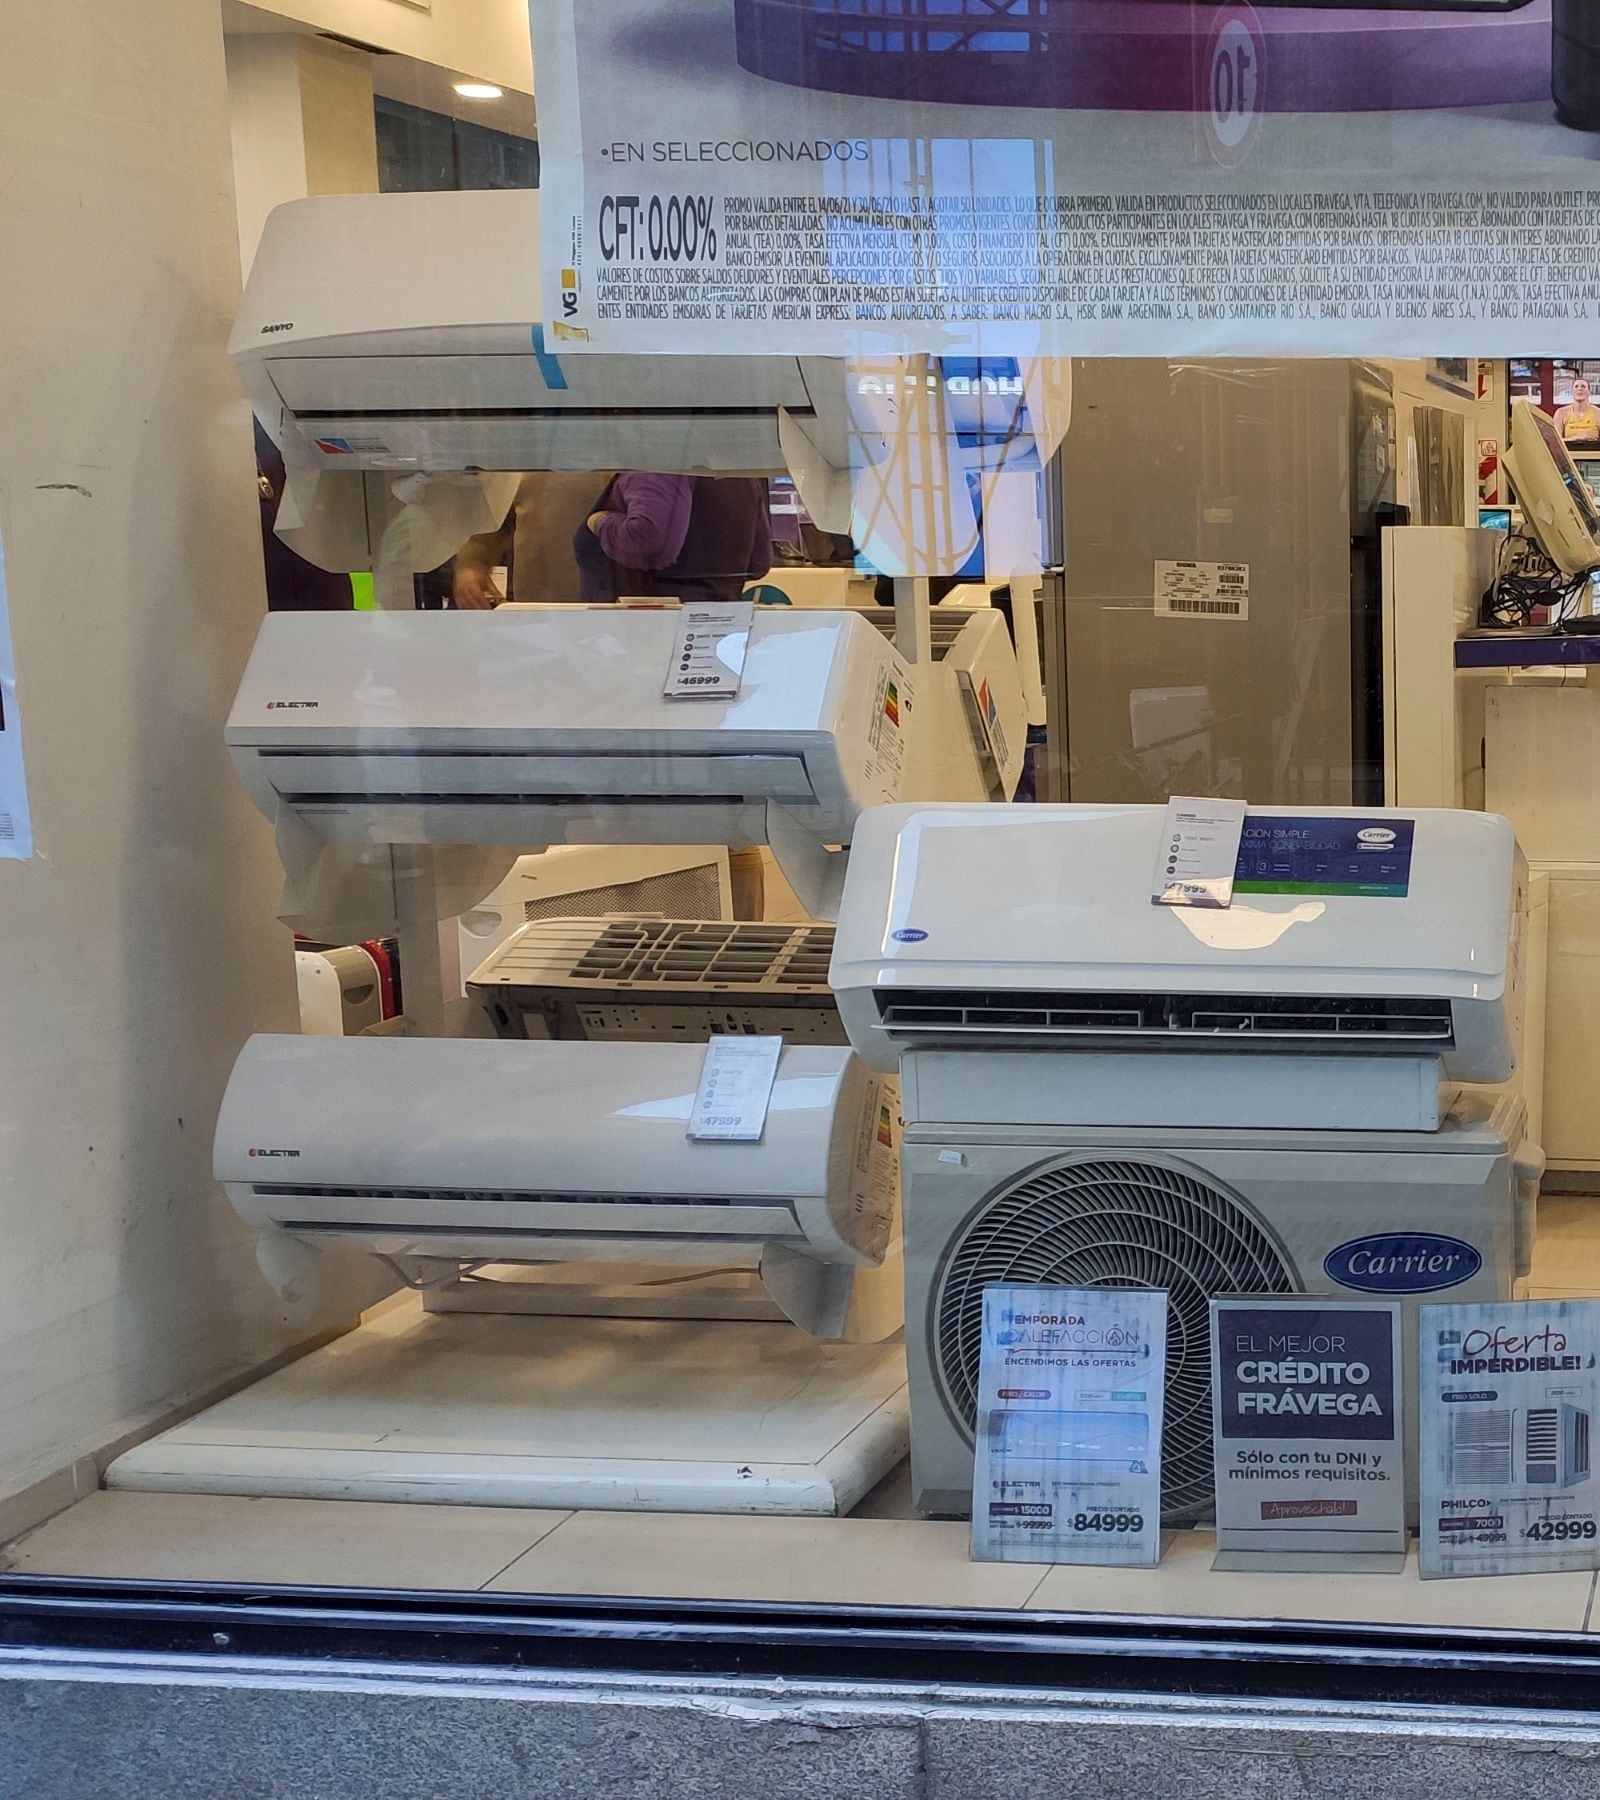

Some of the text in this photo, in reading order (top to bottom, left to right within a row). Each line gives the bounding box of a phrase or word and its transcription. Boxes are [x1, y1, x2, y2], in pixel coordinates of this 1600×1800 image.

[653, 140, 869, 162] SELECCIONADOS
[724, 197, 752, 213] PROMO
[753, 197, 781, 213] VALIDA
[649, 195, 717, 261] 0.00%
[563, 292, 578, 318] VG
[598, 303, 767, 320] ENTES ENTIDADES EMISORAS DE TARJETAS
[261, 322, 294, 334] SANYO
[1273, 829, 1309, 839] SIMPLE
[1362, 830, 1391, 840] Carrier
[896, 929, 926, 941] Carrier
[1348, 1249, 1460, 1275] Carrier
[1236, 1335, 1346, 1353] EL MEJOR
[1462, 1324, 1567, 1359] Oferta
[1004, 1357, 1137, 1368] ENCENDIMOS LAS OFERTAS
[1236, 1356, 1370, 1385] CRÉDITO
[1450, 1355, 1581, 1375] IMPERDIBLE!
[1237, 1387, 1382, 1416] FRÁVEGA
[1236, 1450, 1382, 1468] Sólo con tu DNI y
[1229, 1466, 1391, 1482] mínimos requisitos.
[1020, 1506, 1050, 1515] 15000
[1441, 1499, 1486, 1509] PHILCO
[1067, 1513, 1144, 1533] $84999
[1518, 1520, 1597, 1542] $42999
